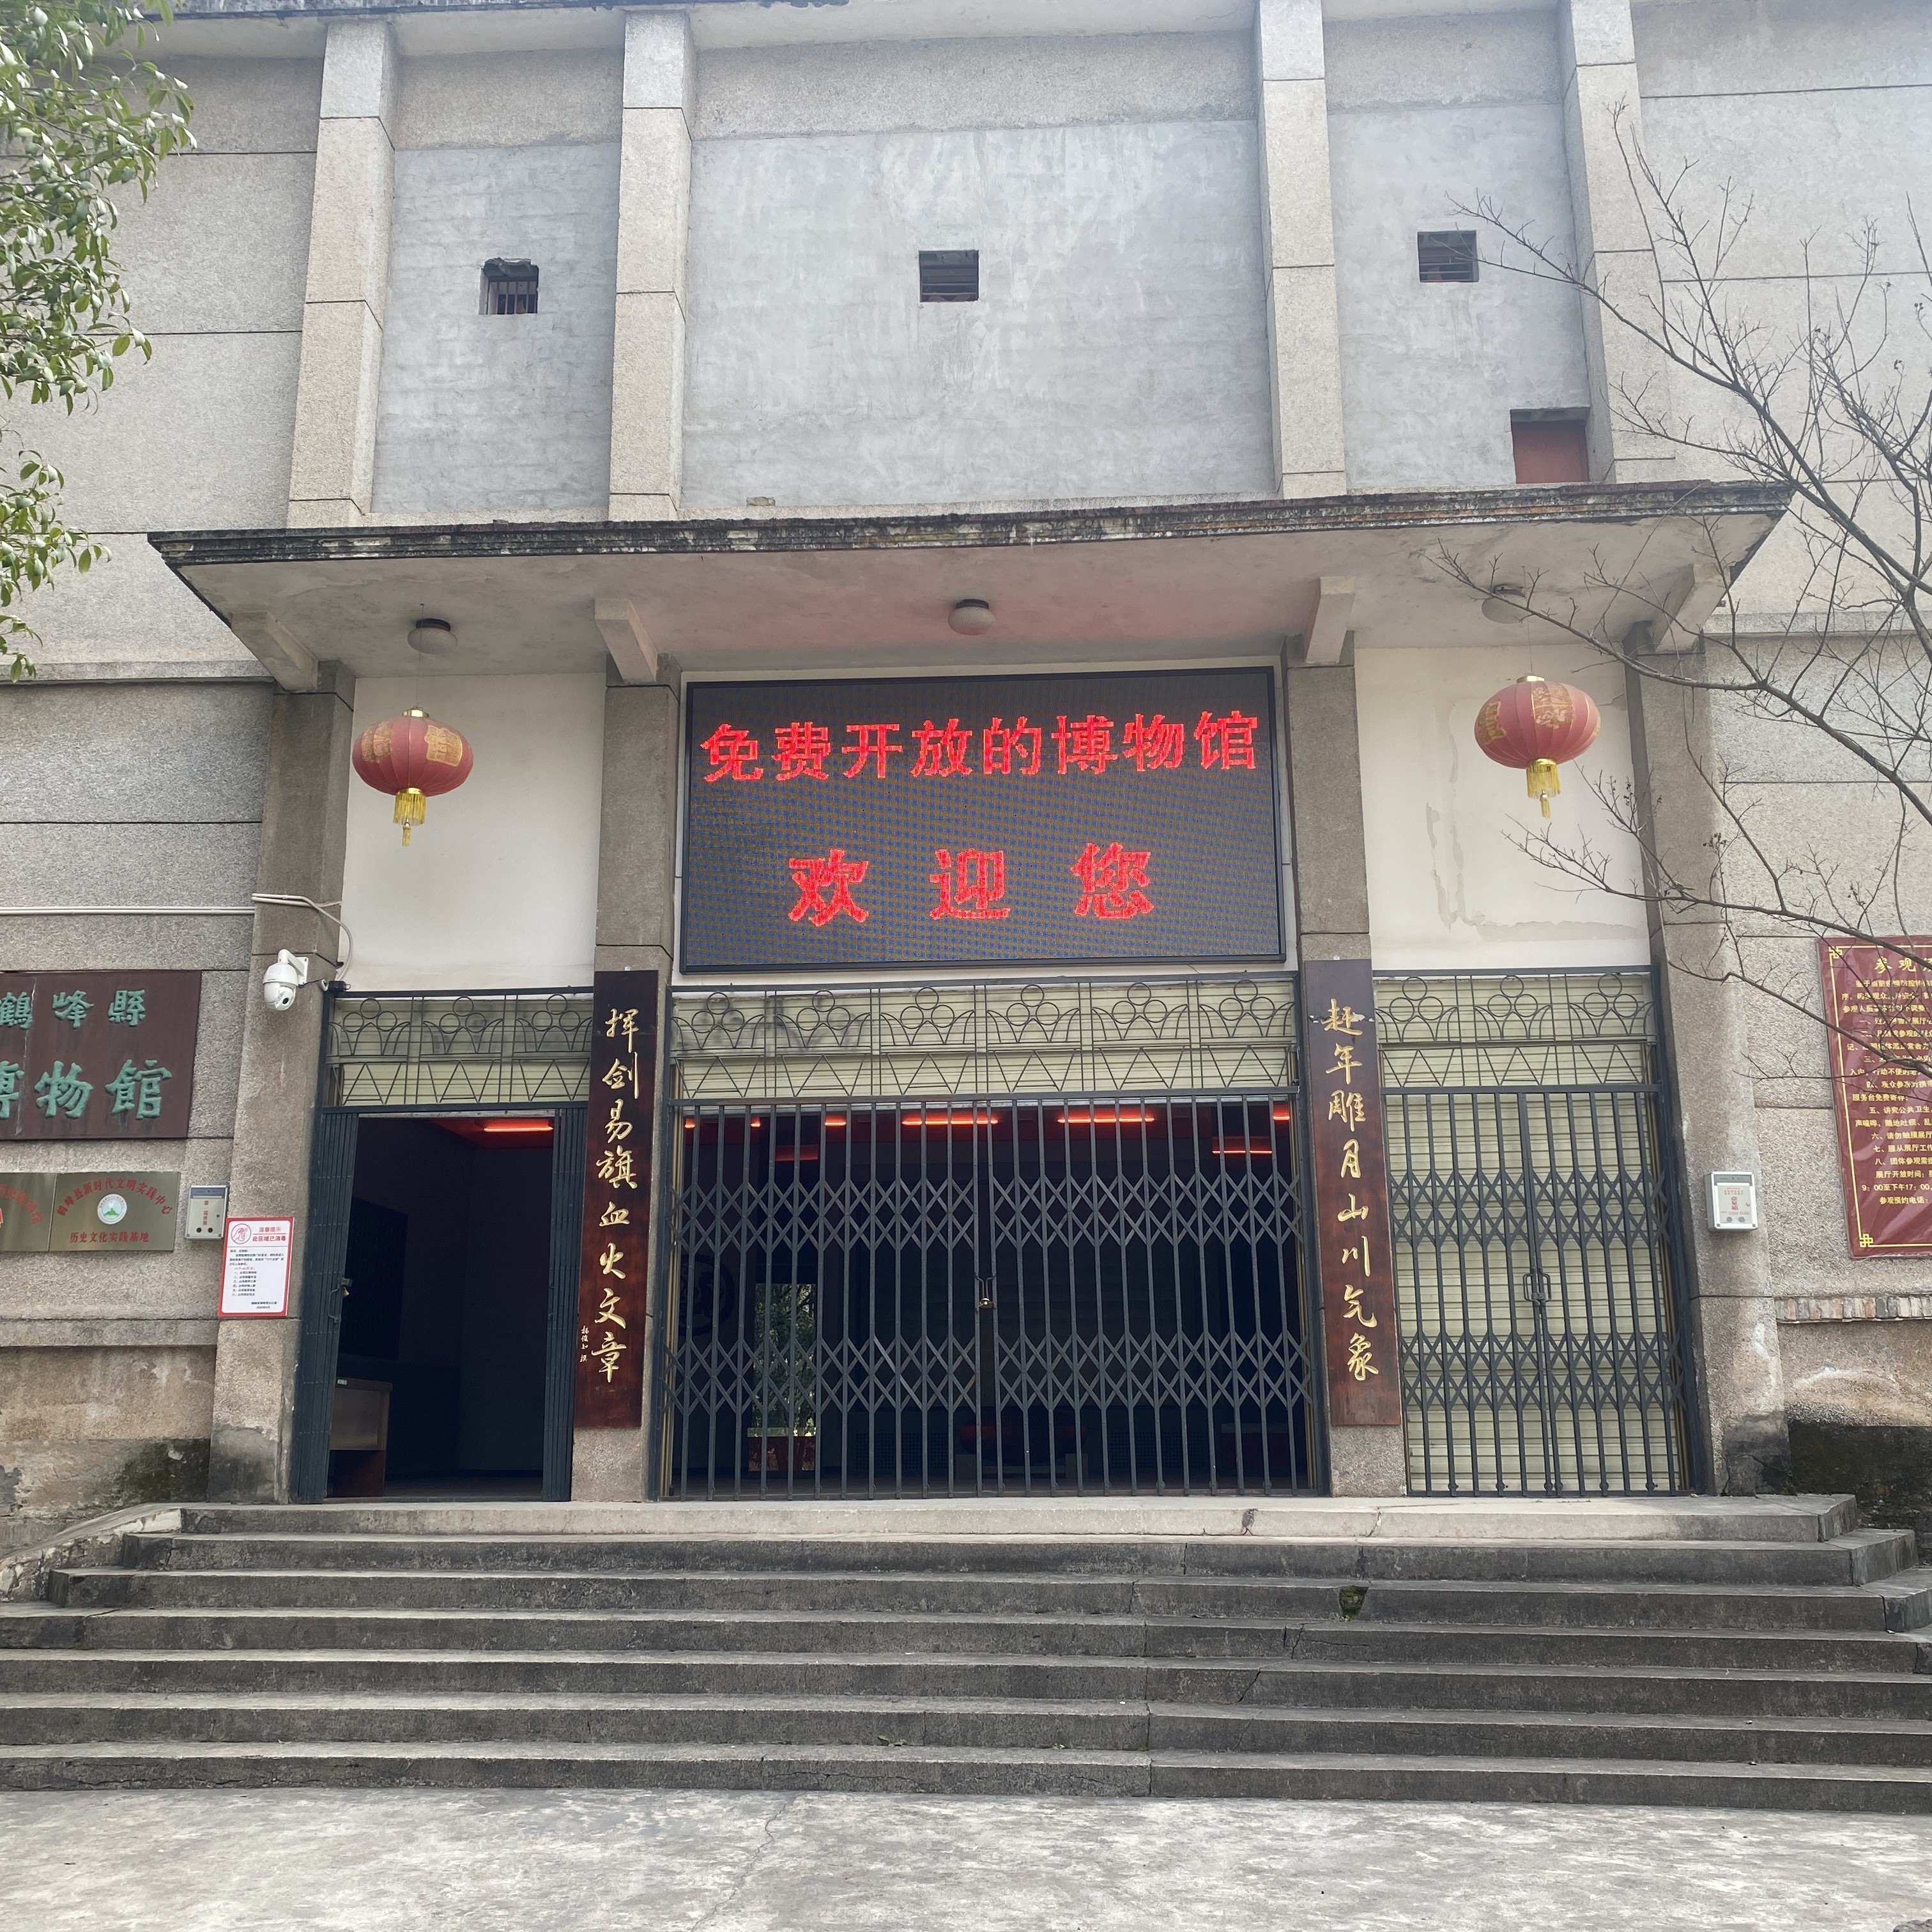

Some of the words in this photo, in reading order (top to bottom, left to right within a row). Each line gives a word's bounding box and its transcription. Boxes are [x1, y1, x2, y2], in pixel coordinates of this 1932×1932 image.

[700, 710, 1258, 783] 免费开放的博物馆
[70, 1231, 150, 1243] 历史文化实践基地
